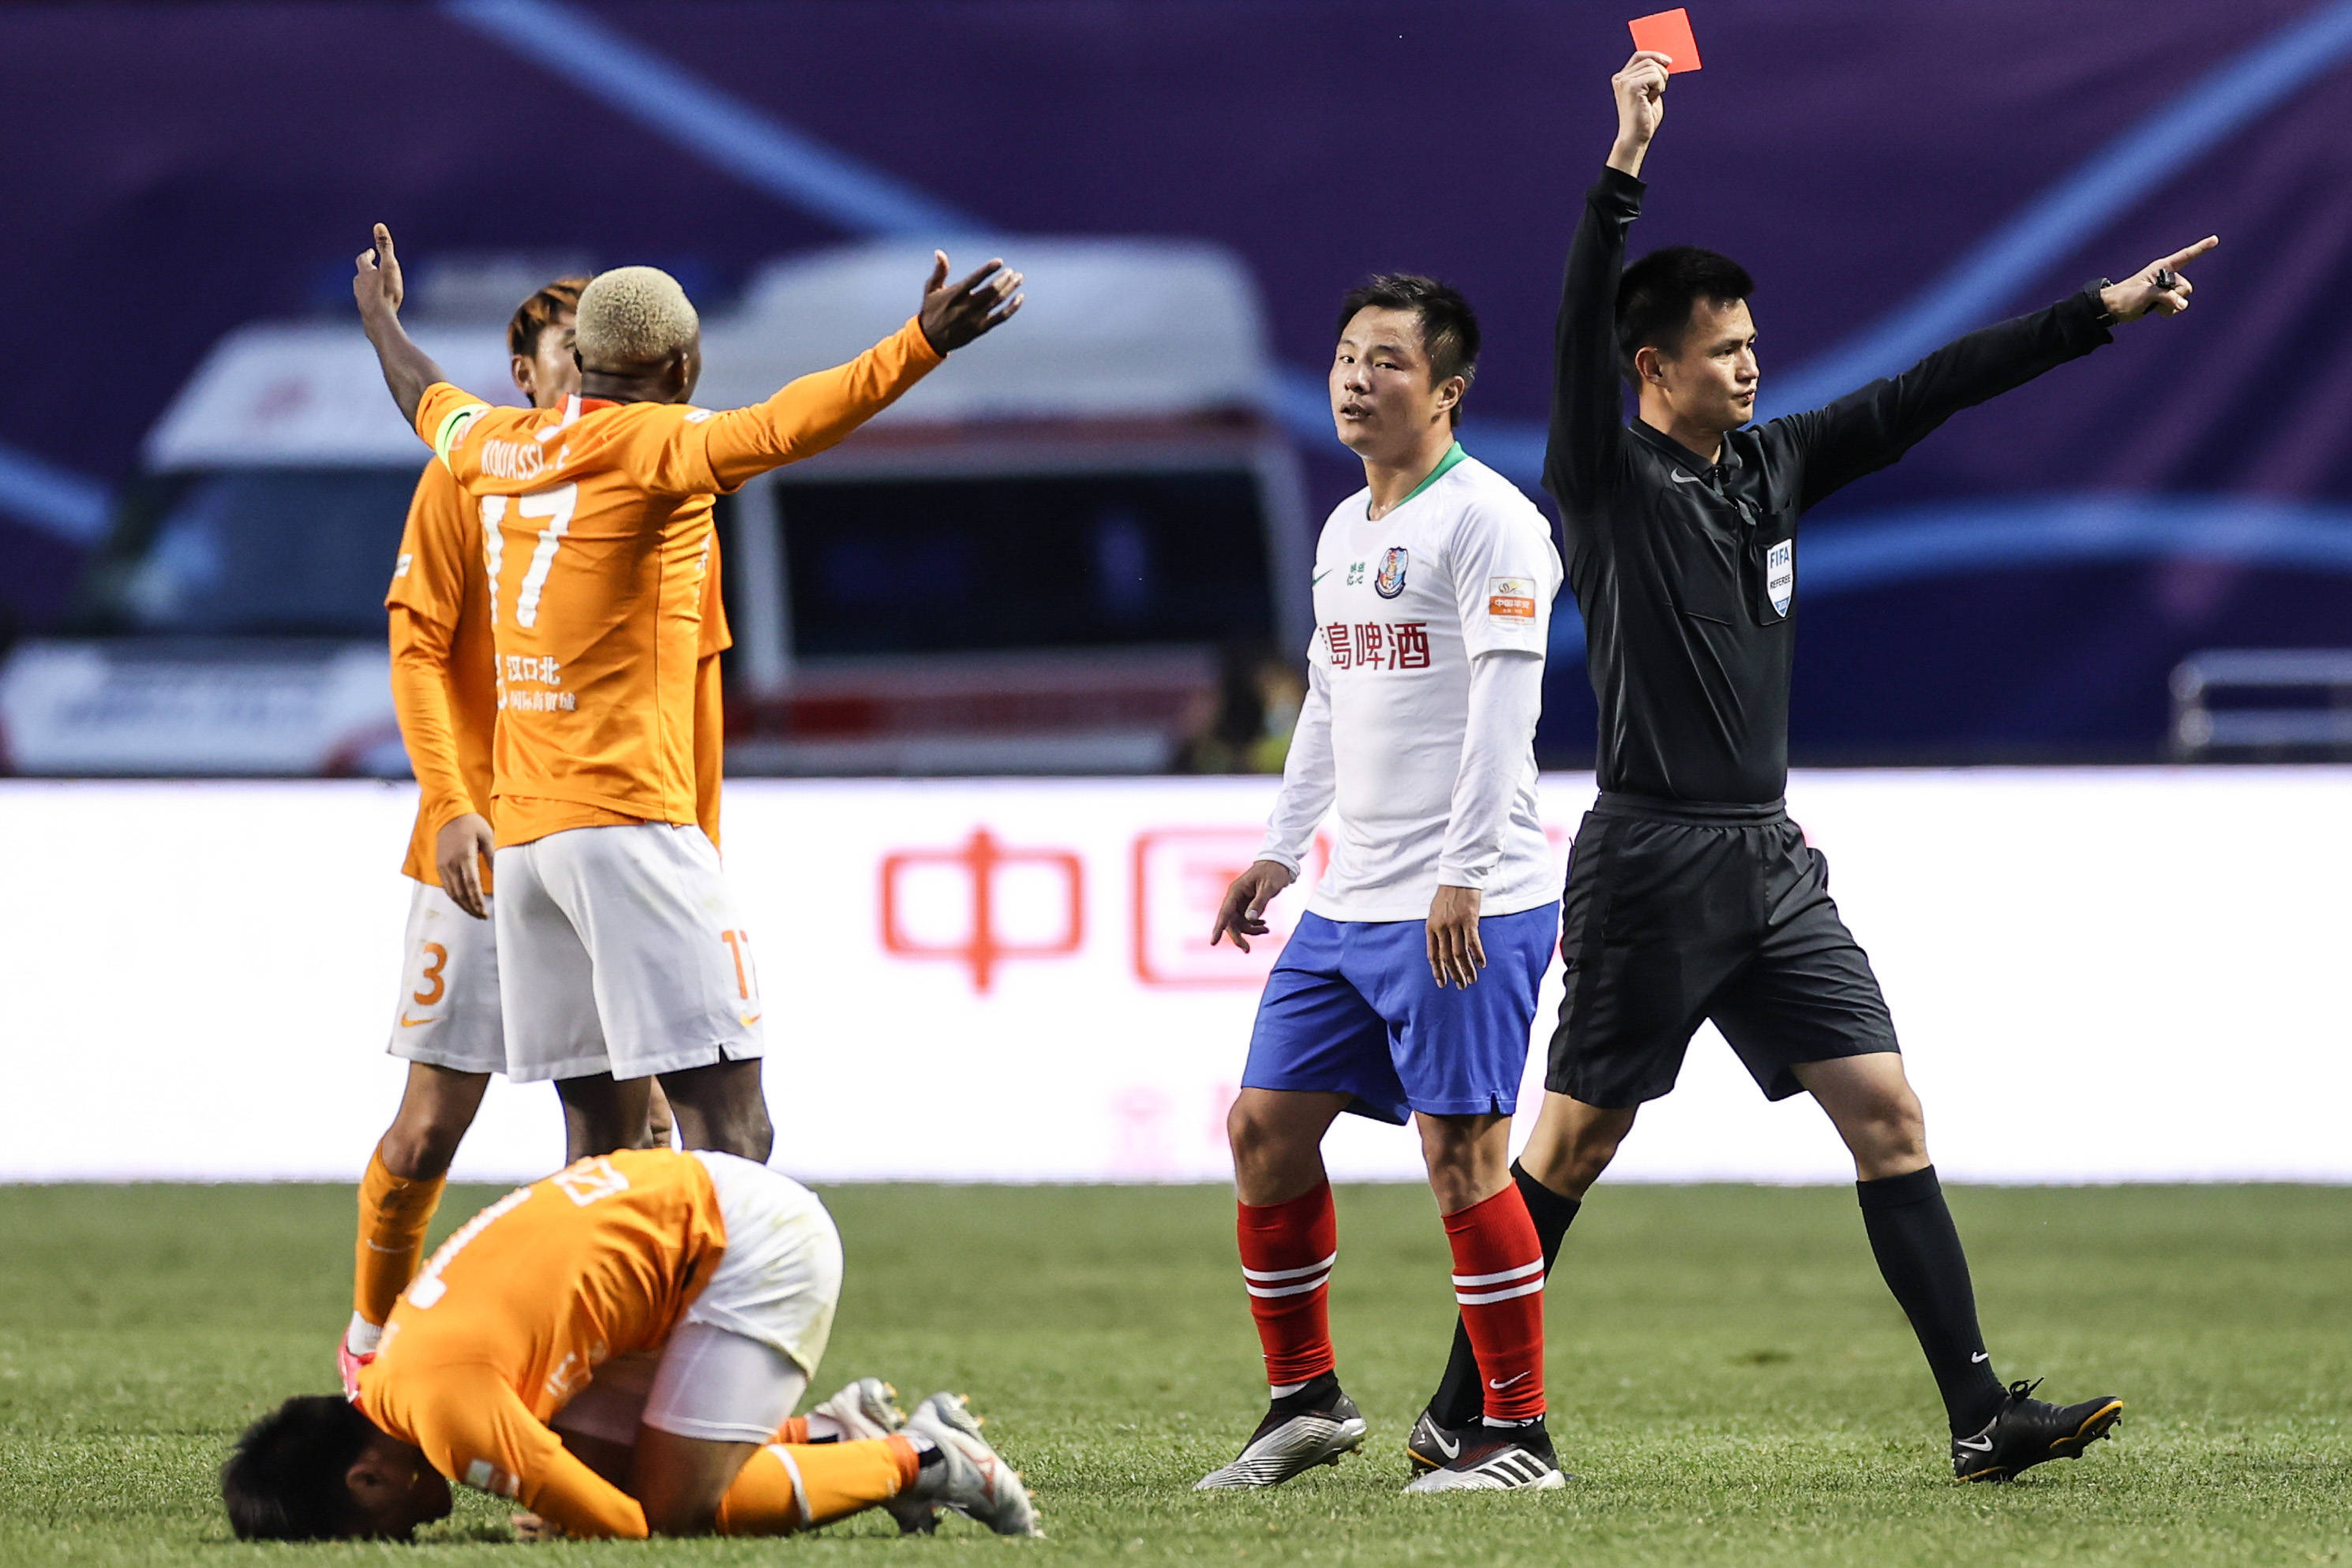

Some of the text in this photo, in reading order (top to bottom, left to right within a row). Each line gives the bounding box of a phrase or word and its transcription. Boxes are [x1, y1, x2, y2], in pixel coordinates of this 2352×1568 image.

[481, 482, 578, 628] 17
[1770, 546, 1790, 568] FIFA
[1770, 574, 1792, 589] REFEREE
[1319, 621, 1430, 670] 島啤酒
[414, 942, 448, 1006] 3
